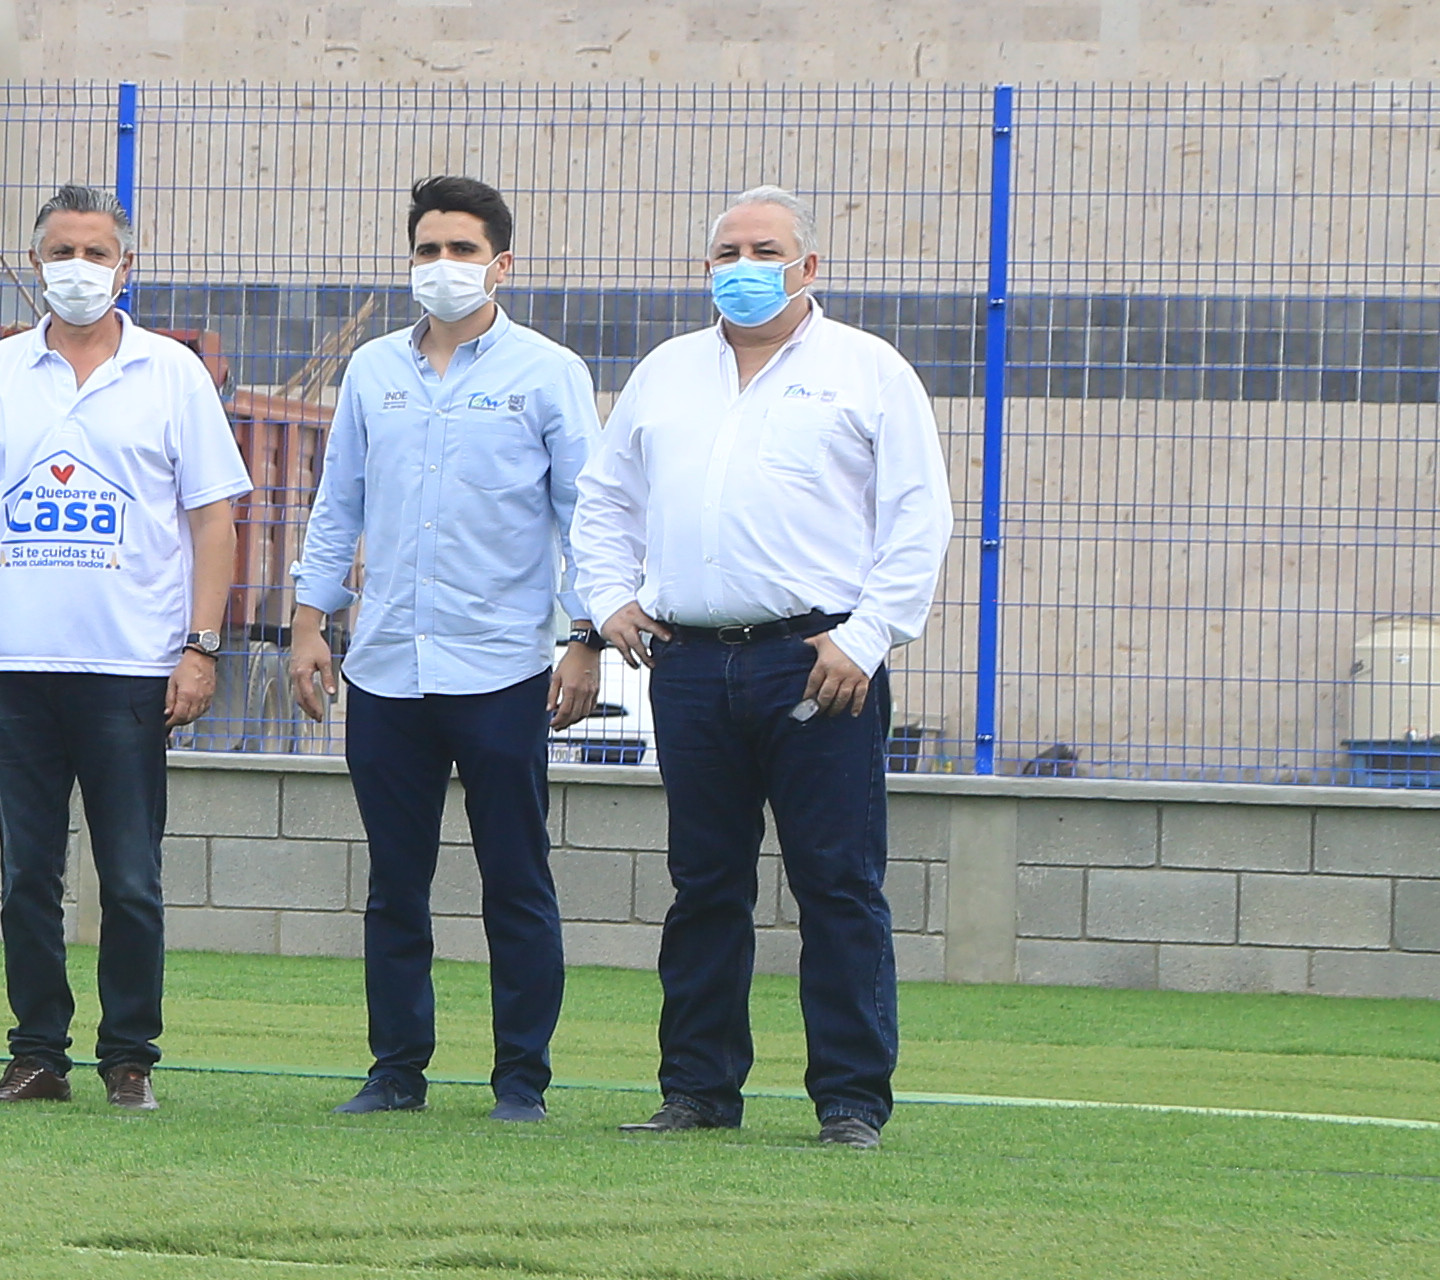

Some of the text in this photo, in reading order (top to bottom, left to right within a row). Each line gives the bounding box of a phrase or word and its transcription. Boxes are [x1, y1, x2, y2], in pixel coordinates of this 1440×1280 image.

[100, 491, 117, 501] en
[8, 490, 117, 534] Casa
[11, 546, 105, 560] Si te cuidas tú
[28, 558, 75, 568] cuidamos
[76, 559, 105, 569] todos
